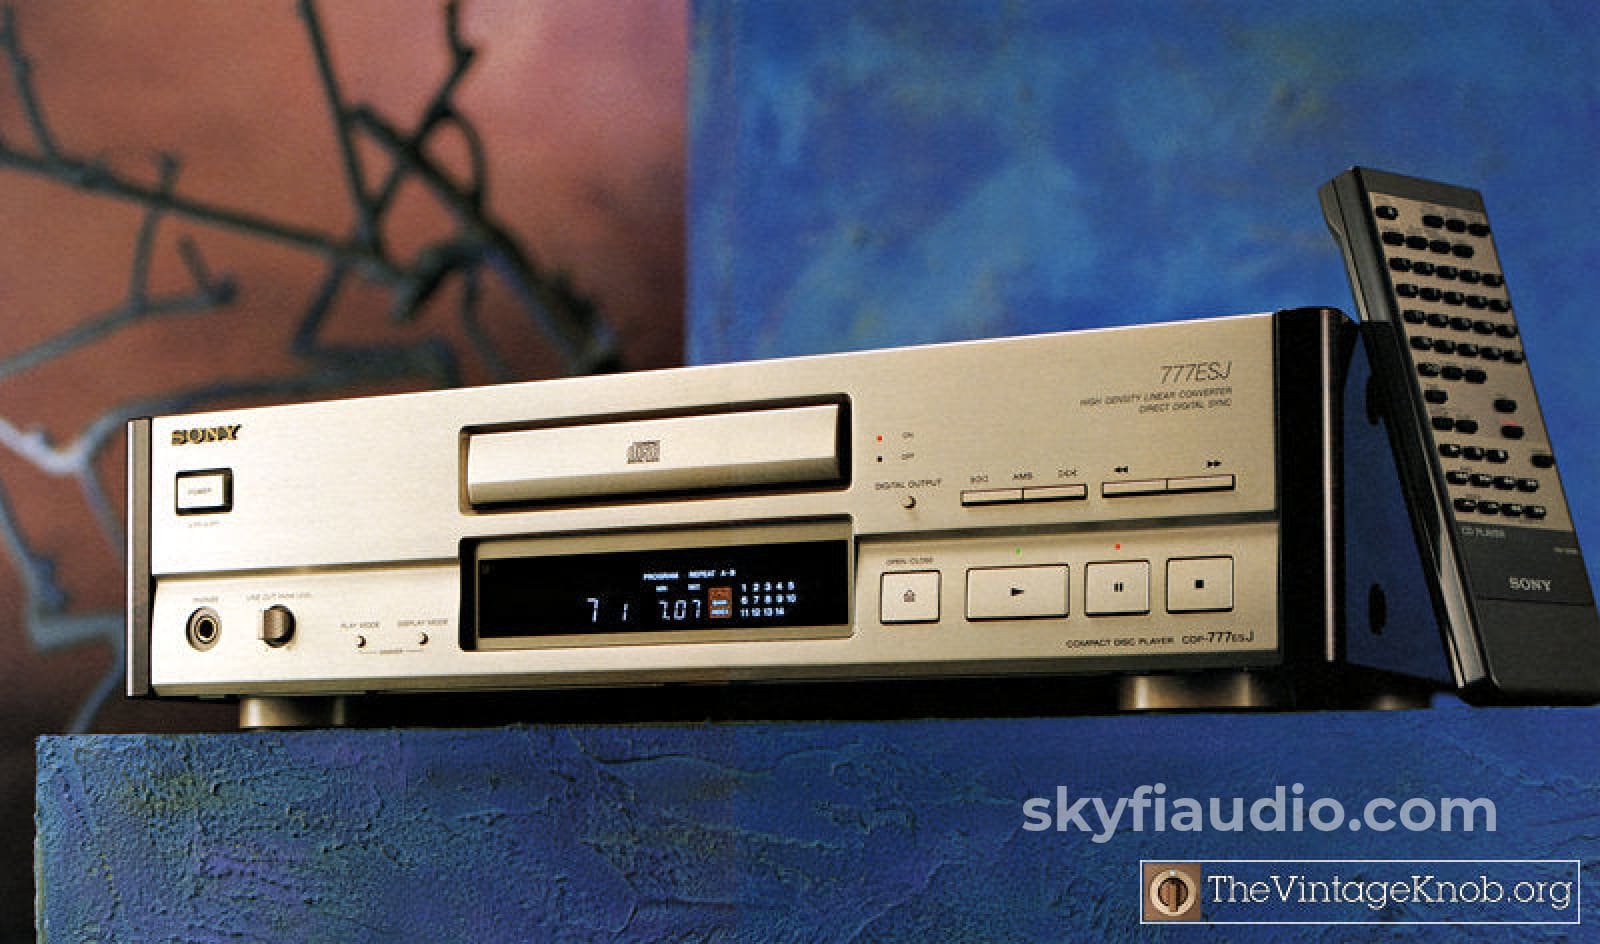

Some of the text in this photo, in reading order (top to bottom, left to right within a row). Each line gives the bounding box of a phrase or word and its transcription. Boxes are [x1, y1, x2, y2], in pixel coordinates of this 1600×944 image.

[1160, 361, 1232, 385] 777ESJ
[1144, 391, 1176, 401] LINEAR
[1179, 386, 1232, 399] CONVERTER
[1139, 398, 1232, 414] DIRECT DIGITAL SYNC
[171, 423, 242, 446] SONY
[1011, 472, 1033, 481] AMS
[875, 478, 943, 491] DIGITAL OUTPUT
[1508, 576, 1552, 593] SONY
[1066, 639, 1110, 648] COMPACT
[1113, 637, 1136, 647] DISC
[1138, 636, 1174, 646] PLAYER
